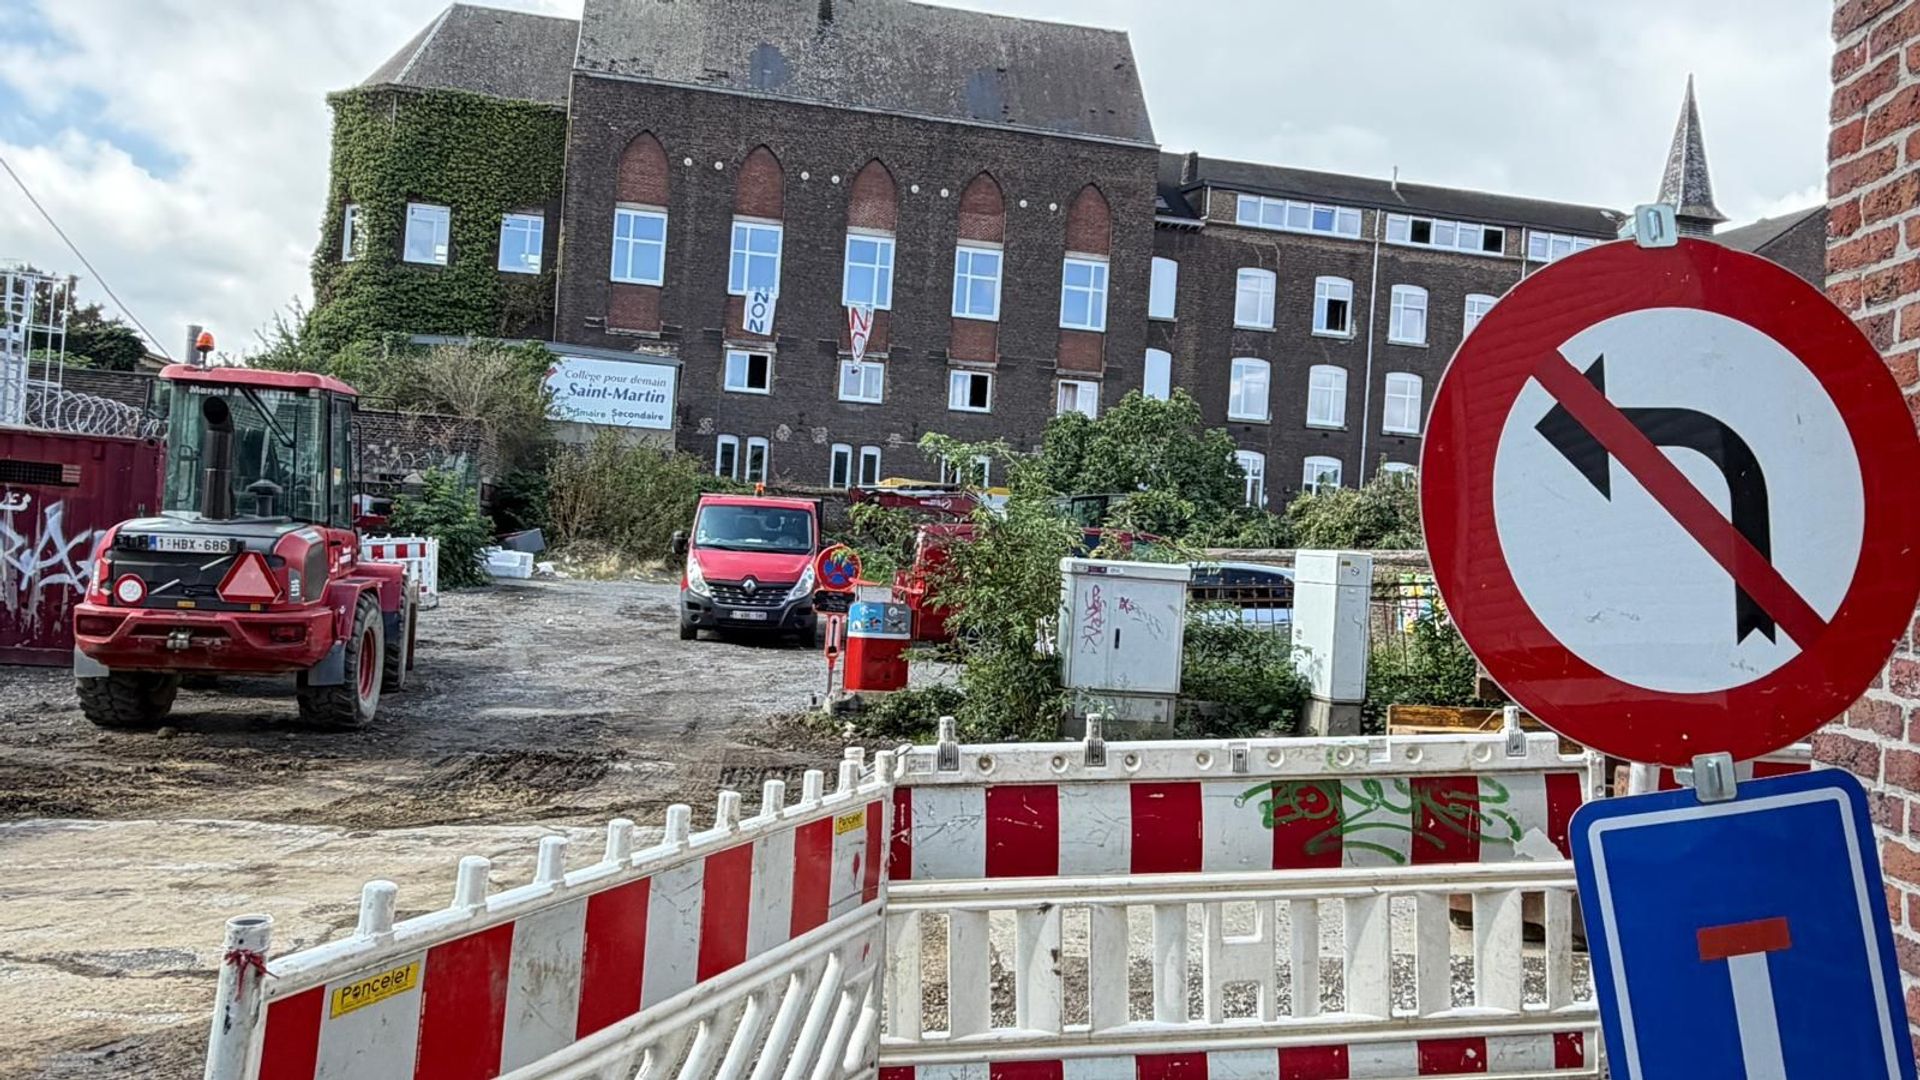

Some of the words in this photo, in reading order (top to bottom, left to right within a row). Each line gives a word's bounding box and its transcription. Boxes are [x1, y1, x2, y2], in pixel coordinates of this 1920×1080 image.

[749, 292, 769, 332] NON
[603, 375, 627, 384] pour
[630, 374, 666, 387] demain
[189, 385, 229, 396] Marcel
[567, 382, 666, 403] Saint-Martin
[611, 408, 664, 421] Secondaire
[340, 966, 410, 1005] Poncelet
